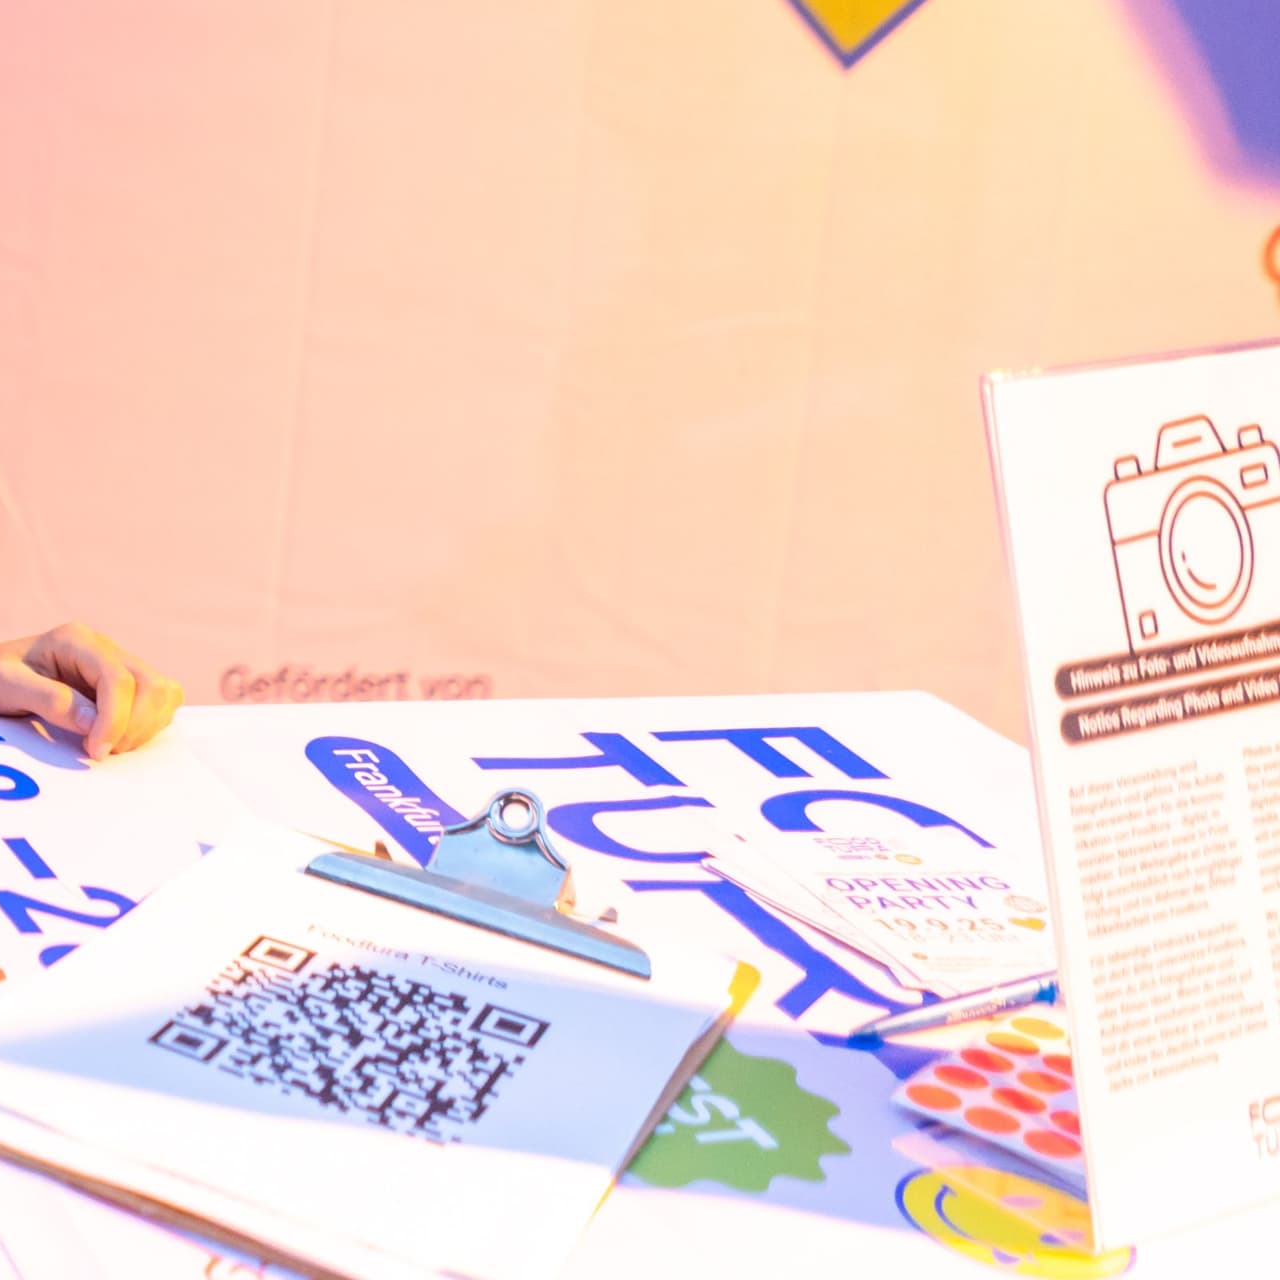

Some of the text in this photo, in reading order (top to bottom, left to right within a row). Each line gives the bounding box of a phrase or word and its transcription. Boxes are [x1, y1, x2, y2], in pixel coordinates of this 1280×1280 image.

[419, 673, 493, 700] von
[1070, 663, 1121, 694] Hinweis
[1122, 664, 1138, 682] zu
[1172, 648, 1197, 670] und
[1078, 711, 1121, 738] Notice
[1120, 698, 1183, 728] Regarding
[1183, 687, 1220, 713] Photo
[1220, 681, 1244, 706] and
[824, 874, 1011, 893] OPENING
[845, 895, 980, 910] PARTY
[307, 923, 509, 991] Foodtura T-Shirts
